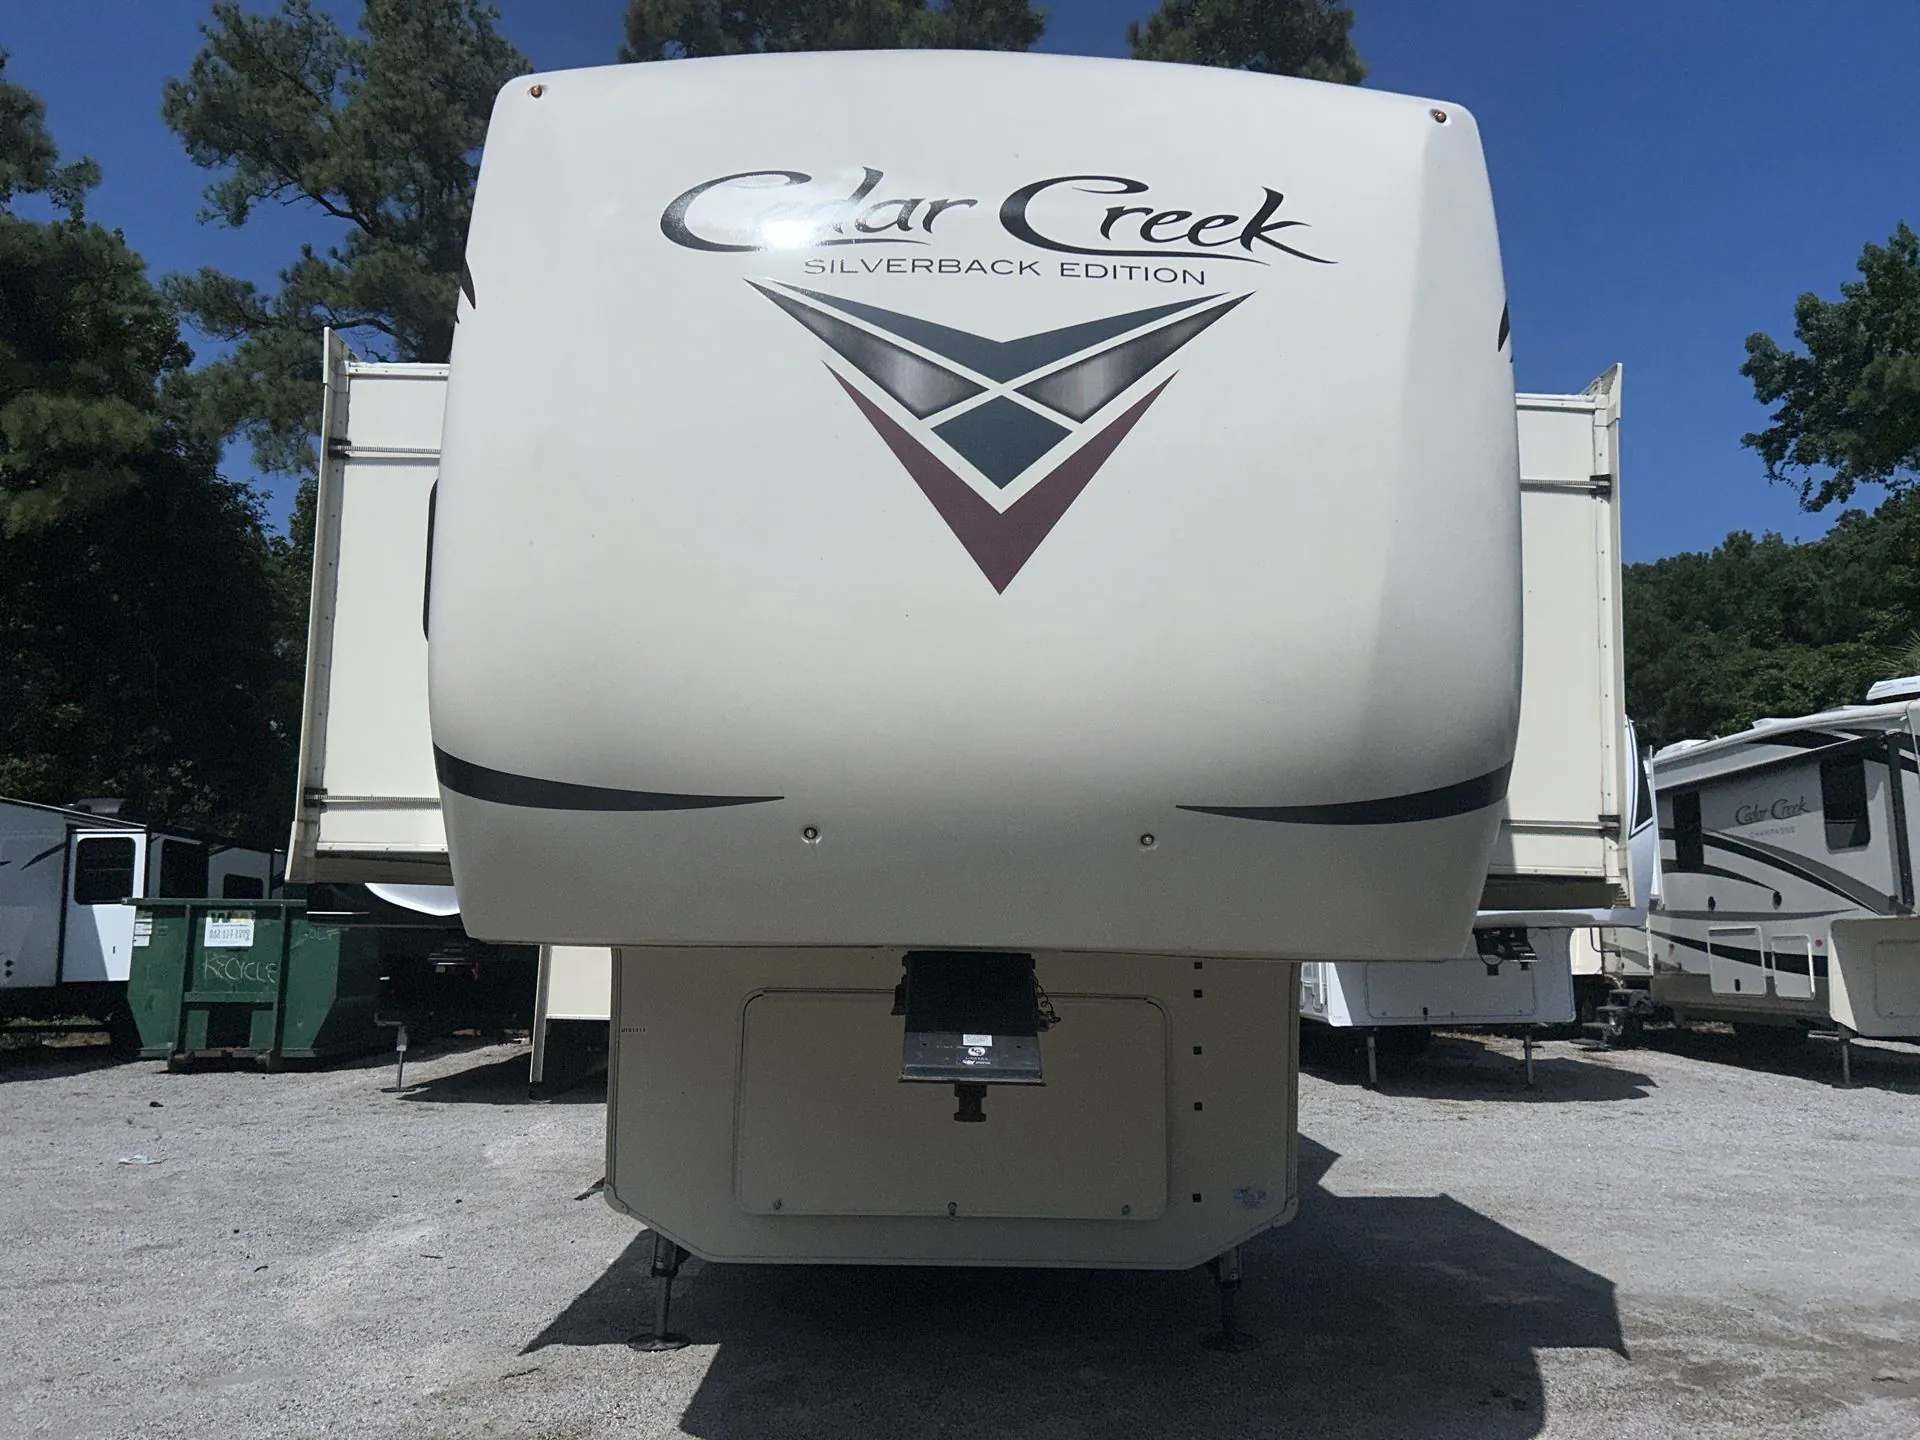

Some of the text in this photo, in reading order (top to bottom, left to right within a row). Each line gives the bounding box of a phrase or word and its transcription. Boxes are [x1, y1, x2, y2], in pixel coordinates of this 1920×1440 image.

[998, 174, 1340, 265] Creek
[804, 257, 1206, 286] SILVERBACK EDITION
[1771, 796, 1812, 820] Creek
[203, 952, 277, 985] RECYCLE
